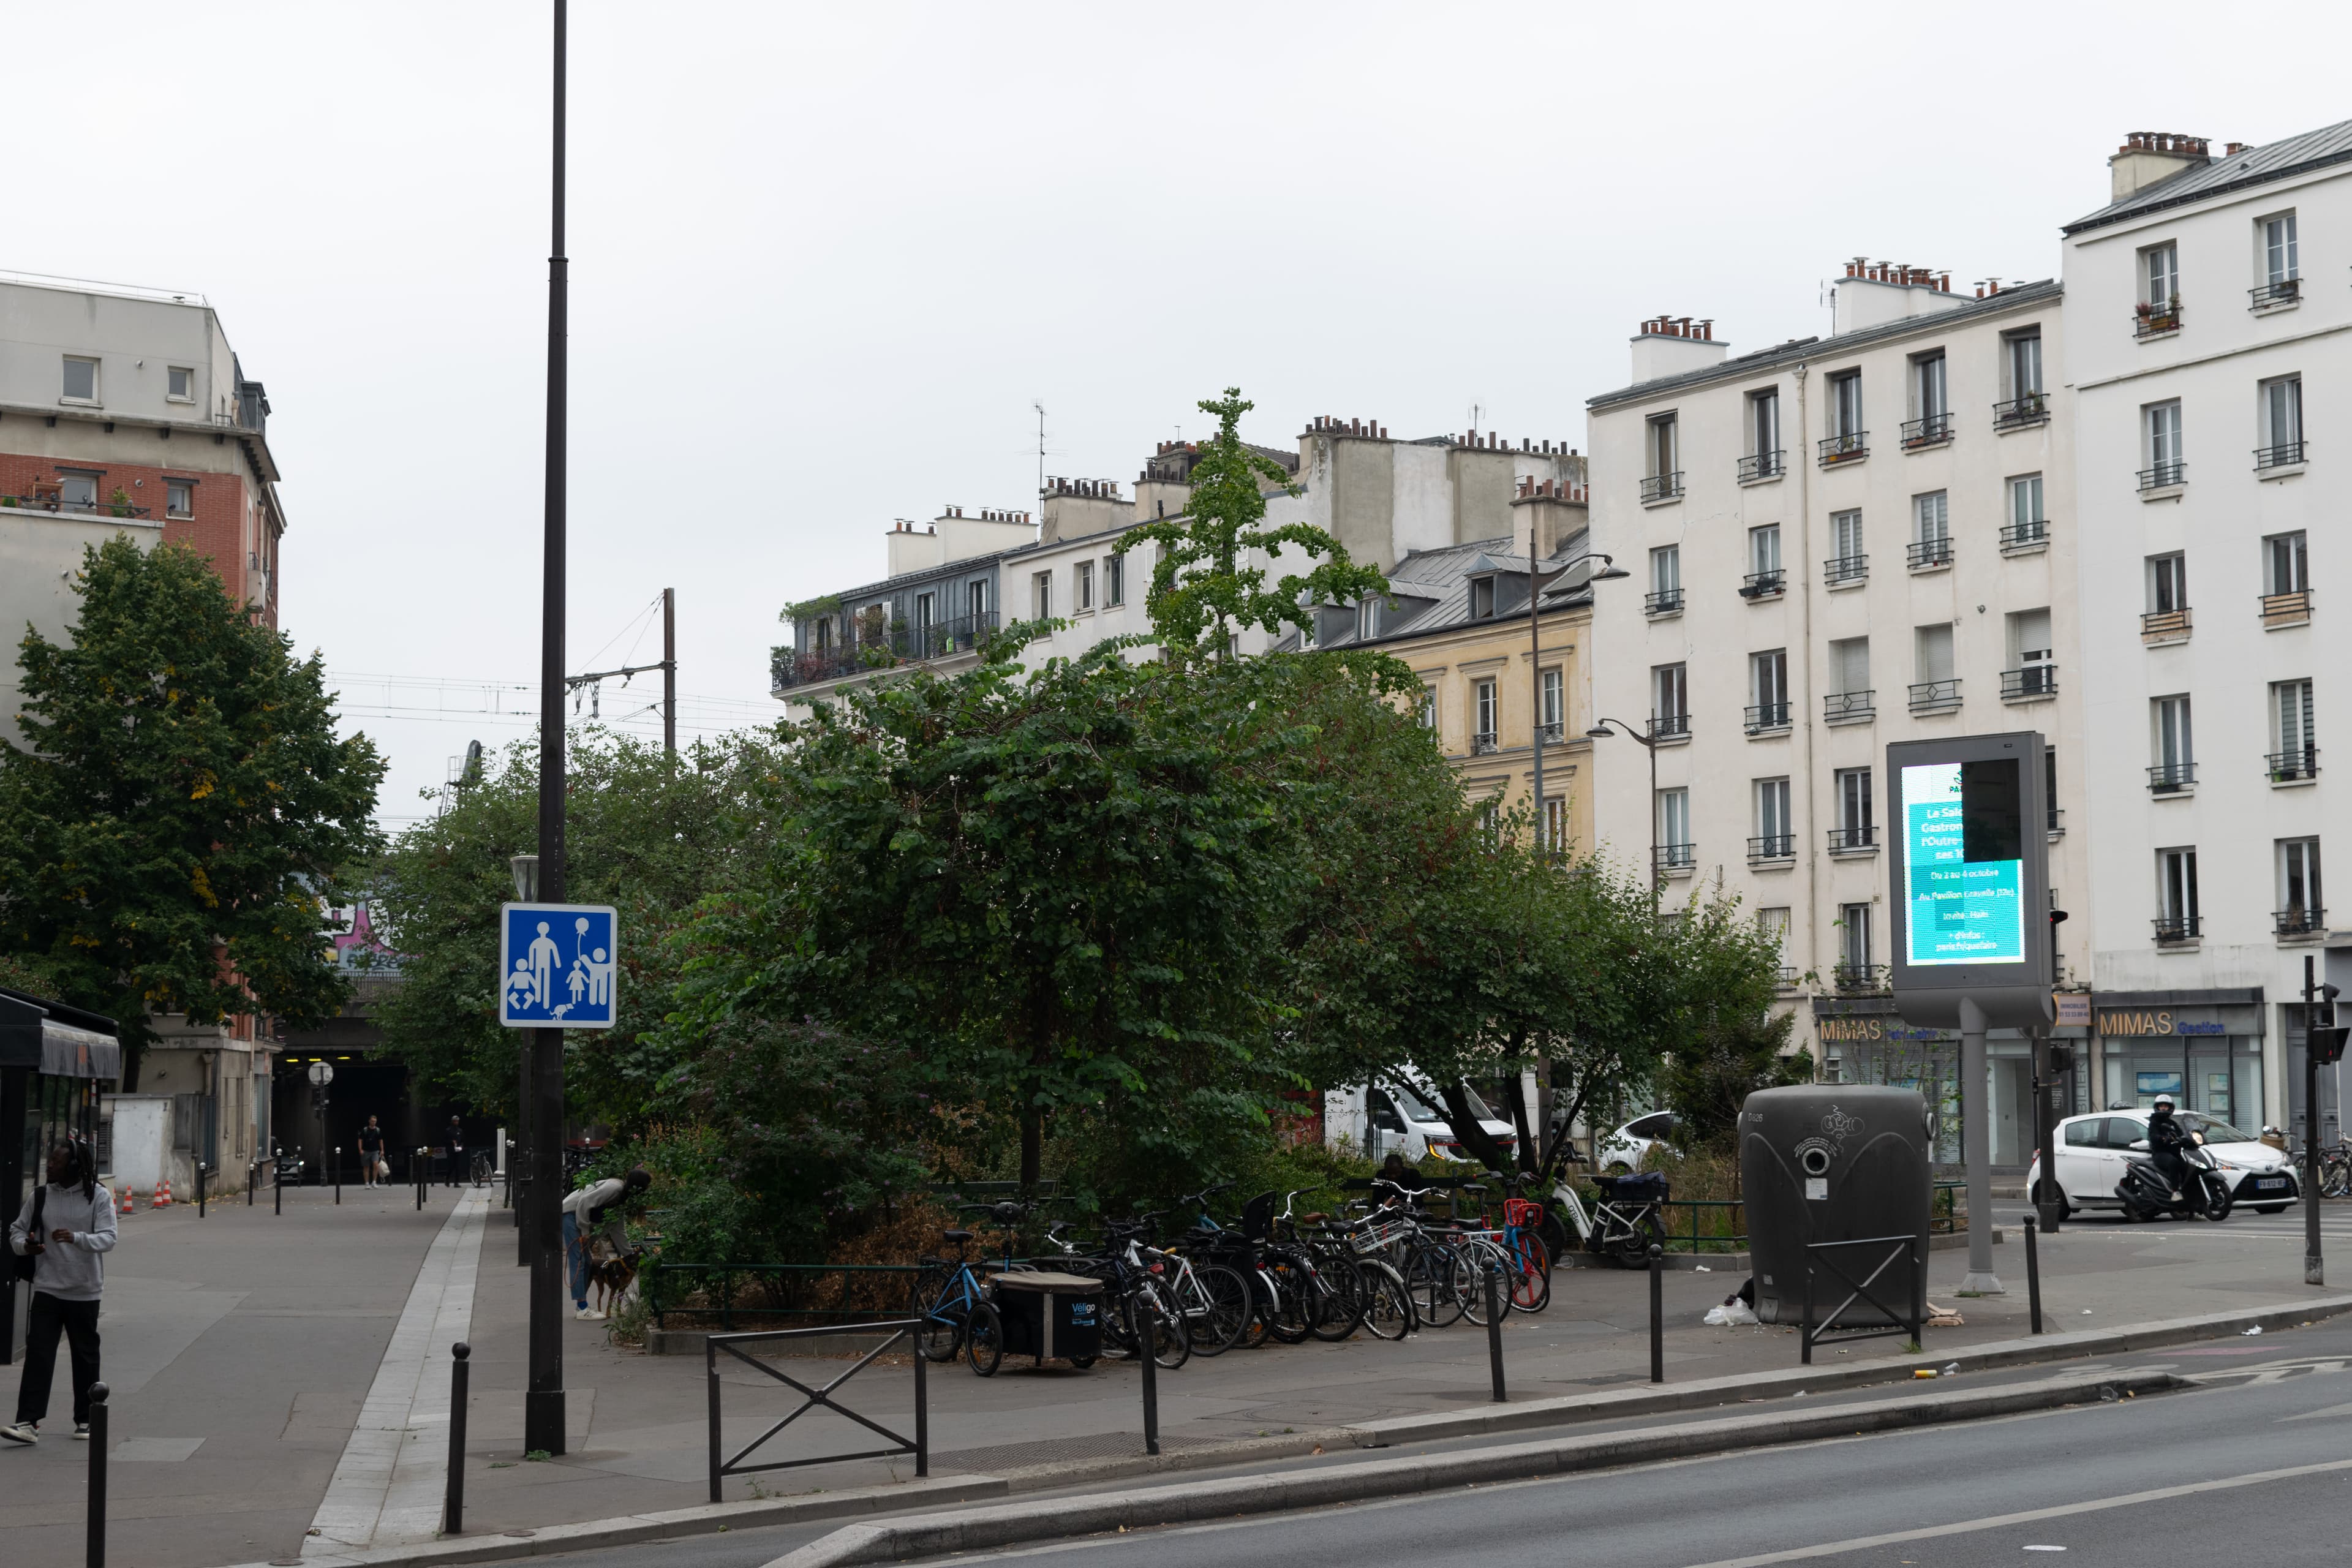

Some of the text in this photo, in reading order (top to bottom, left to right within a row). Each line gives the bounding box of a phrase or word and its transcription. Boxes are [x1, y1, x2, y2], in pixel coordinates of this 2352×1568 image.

[1927, 809, 1940, 819] Le
[1931, 872, 1943, 880] Du
[1932, 891, 1963, 900] Pavillon
[2100, 1012, 2225, 1035] MIMAS Gestion
[1821, 1019, 1882, 1040] MIMAS
[1072, 1303, 1095, 1314] Véligo
